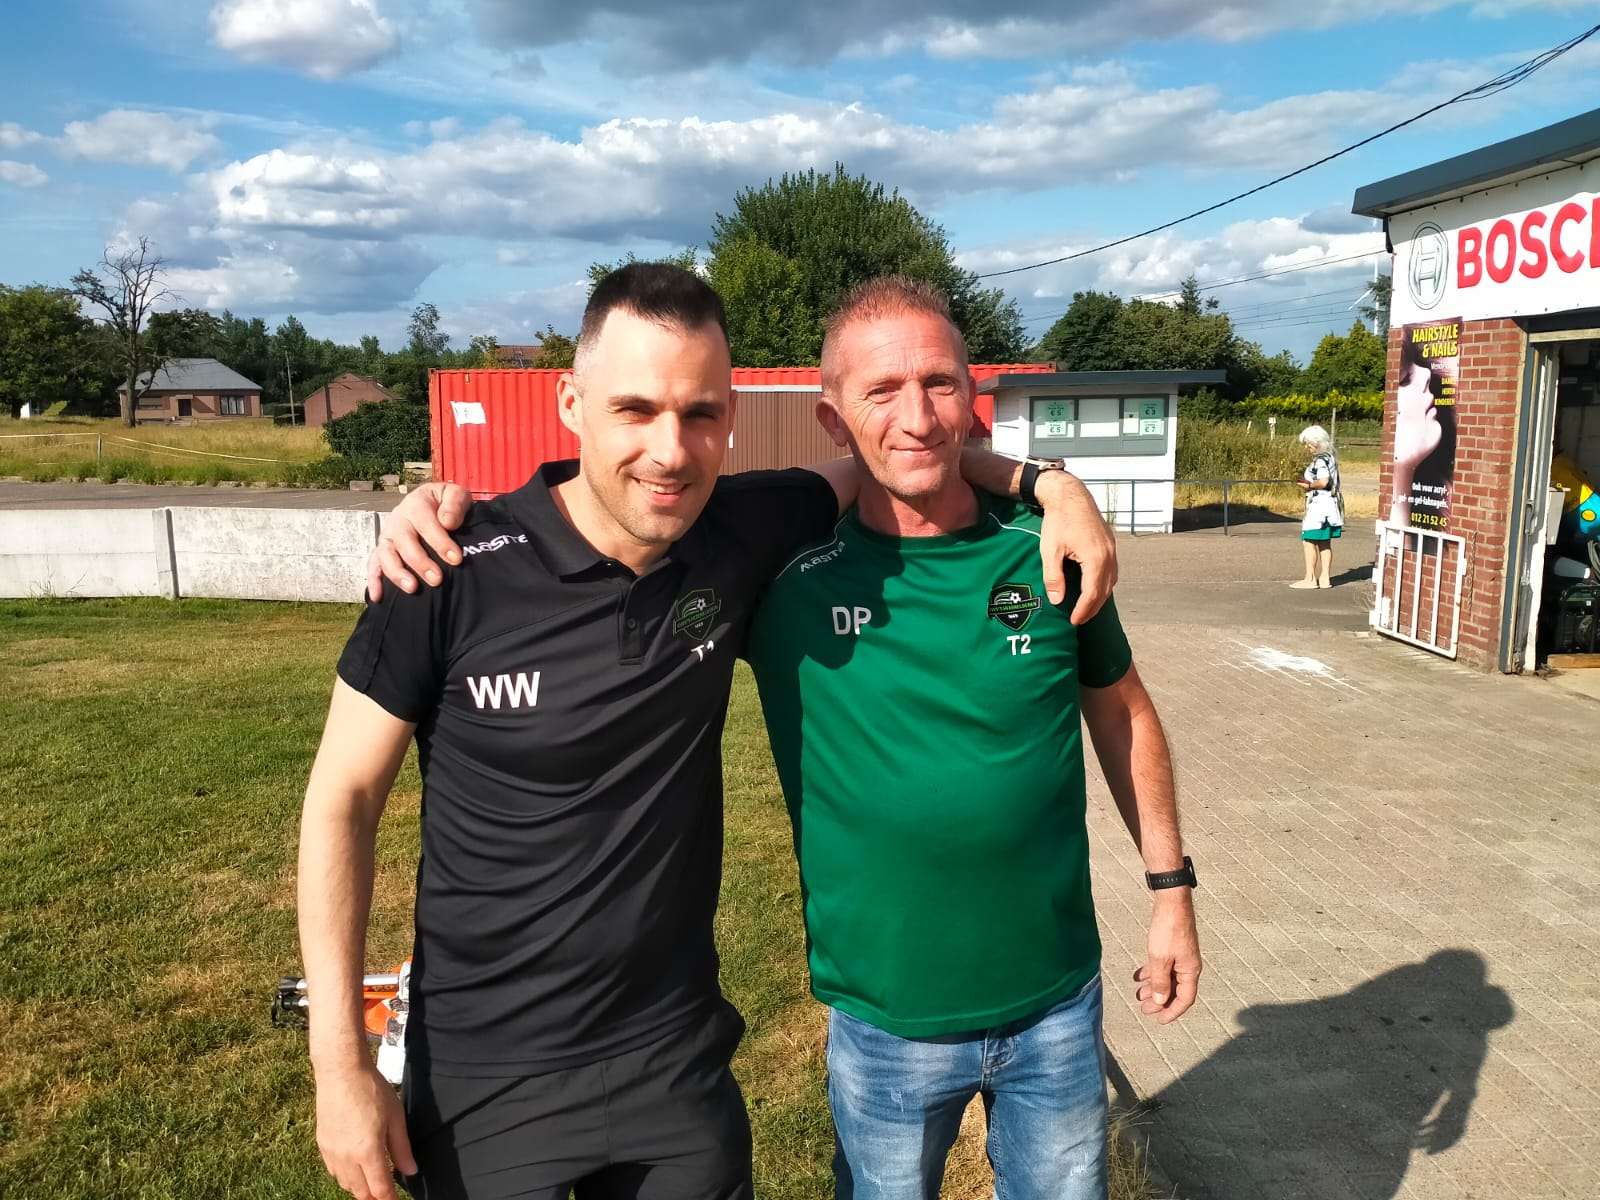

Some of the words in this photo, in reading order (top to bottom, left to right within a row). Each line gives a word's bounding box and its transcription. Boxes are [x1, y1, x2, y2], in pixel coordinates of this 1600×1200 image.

[1412, 324, 1459, 343] HAIRSTYLE
[1422, 344, 1430, 358] &
[1431, 341, 1458, 357] NAILS
[1411, 512, 1422, 523] 012
[1422, 514, 1430, 524] 21
[1430, 515, 1438, 526] 52
[832, 606, 872, 635] DP
[1006, 634, 1031, 656] T2
[467, 671, 540, 710] WW
